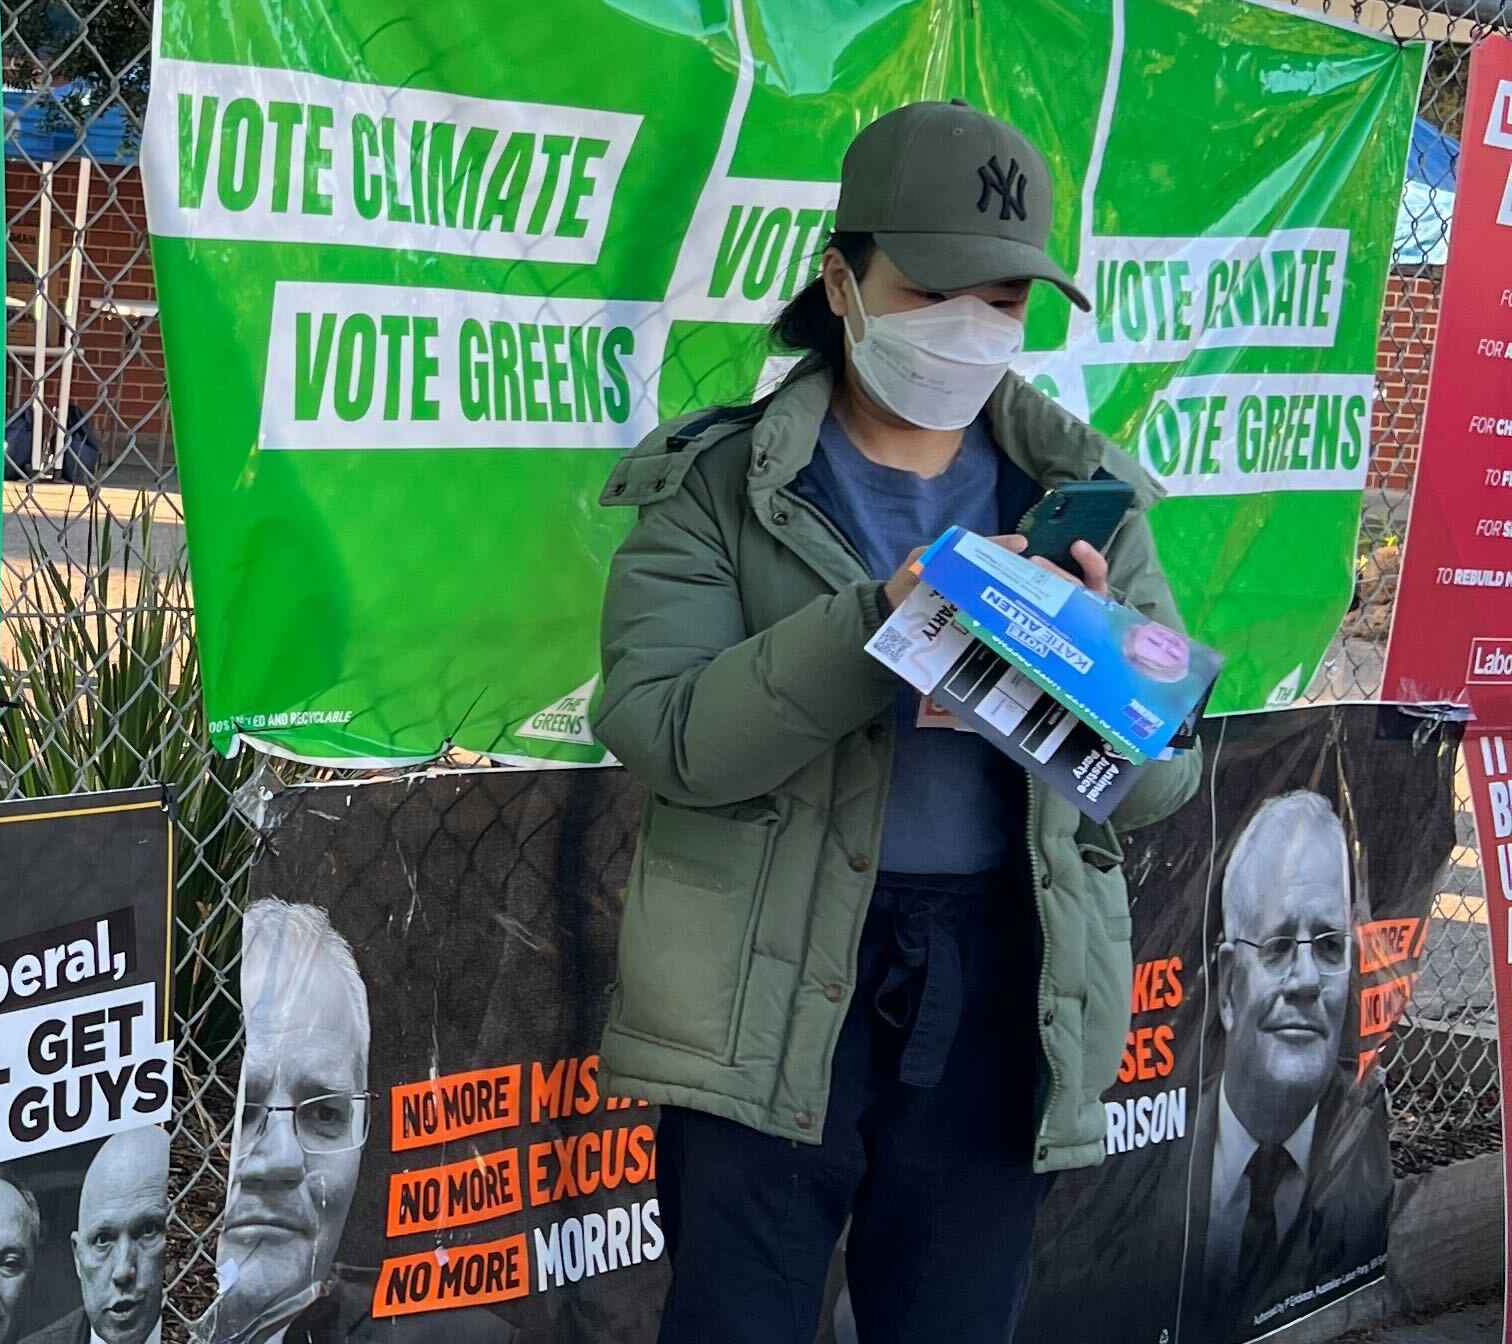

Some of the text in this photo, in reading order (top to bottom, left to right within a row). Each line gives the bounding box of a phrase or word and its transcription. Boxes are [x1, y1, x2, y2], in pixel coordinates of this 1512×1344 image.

[176, 92, 611, 239] VOTE CLIMATE
[1094, 259, 1192, 344] VOTE
[294, 312, 635, 425] VOTE GREENS
[1477, 338, 1504, 358] FOR
[1468, 415, 1495, 435] FOR
[1485, 468, 1501, 487] TO
[1476, 519, 1502, 537] FOR
[1436, 567, 1453, 585] TO
[1453, 568, 1504, 587] REBUILD
[986, 590, 1041, 632] ALLEN
[1039, 628, 1090, 670] KATIE
[267, 713, 289, 727] AND
[290, 711, 353, 725] RECYCLABLE
[530, 711, 586, 735] GREENS
[555, 695, 586, 713] THE
[1072, 749, 1101, 779] Party
[1076, 756, 1110, 794] Justice
[1085, 763, 1120, 803] Animal
[27, 1000, 145, 1076] GET
[8, 1057, 169, 1144] GUYS
[402, 1089, 435, 1139] NO
[443, 1076, 510, 1131] MORE
[1104, 1086, 1187, 1155] RISON
[398, 1123, 656, 1226] NO MORE EXCUS
[384, 1198, 666, 1306] NO MORE MORRIS
